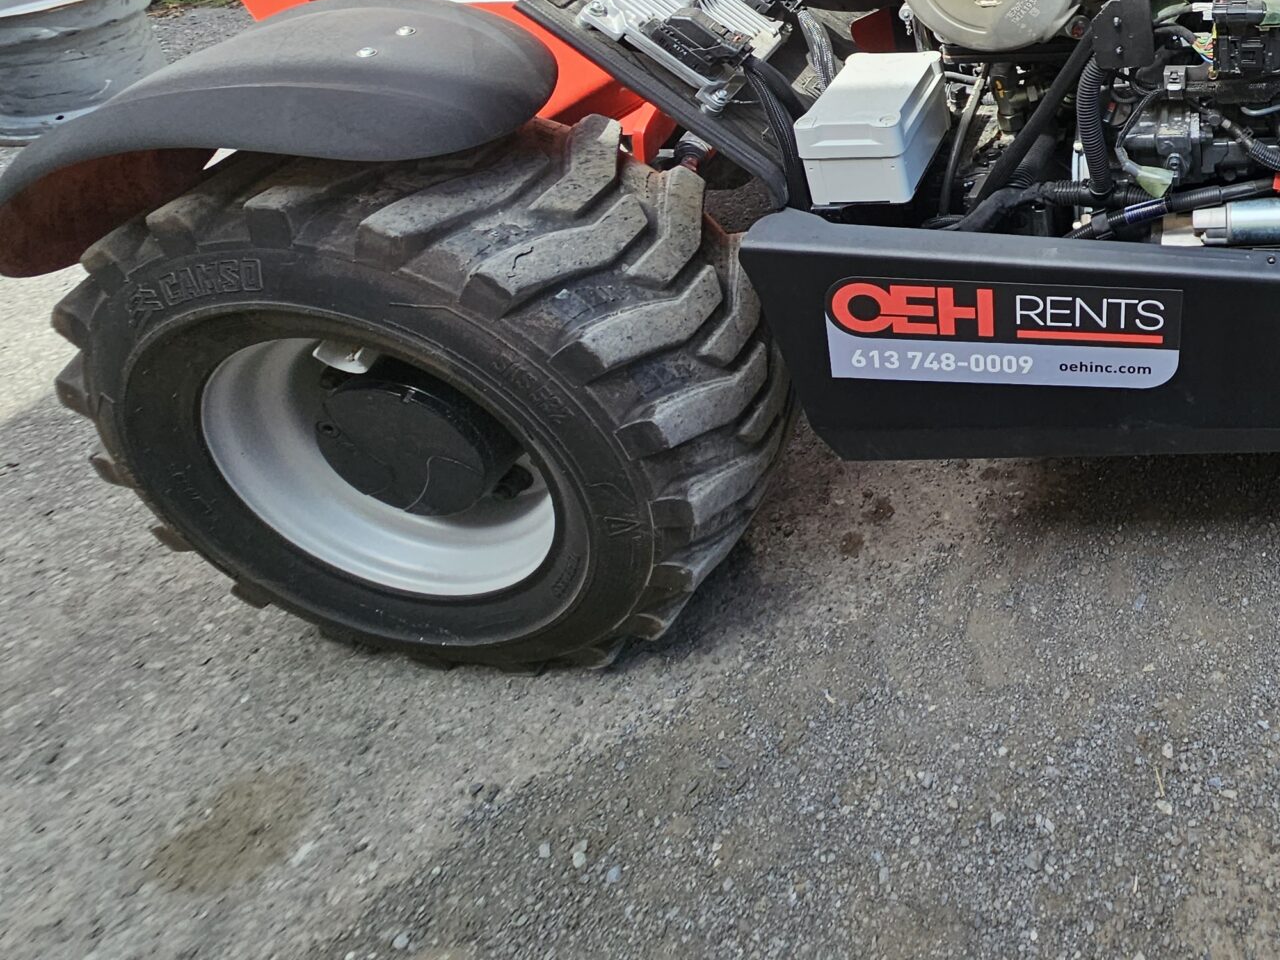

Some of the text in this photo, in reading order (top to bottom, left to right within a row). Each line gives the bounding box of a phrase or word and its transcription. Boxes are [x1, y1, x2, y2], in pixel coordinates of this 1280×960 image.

[158, 256, 265, 306] CAMSO
[832, 282, 1165, 337] OEH RENTS
[850, 348, 1034, 375] 613 748-0009
[1058, 360, 1153, 376] oehinc.com
